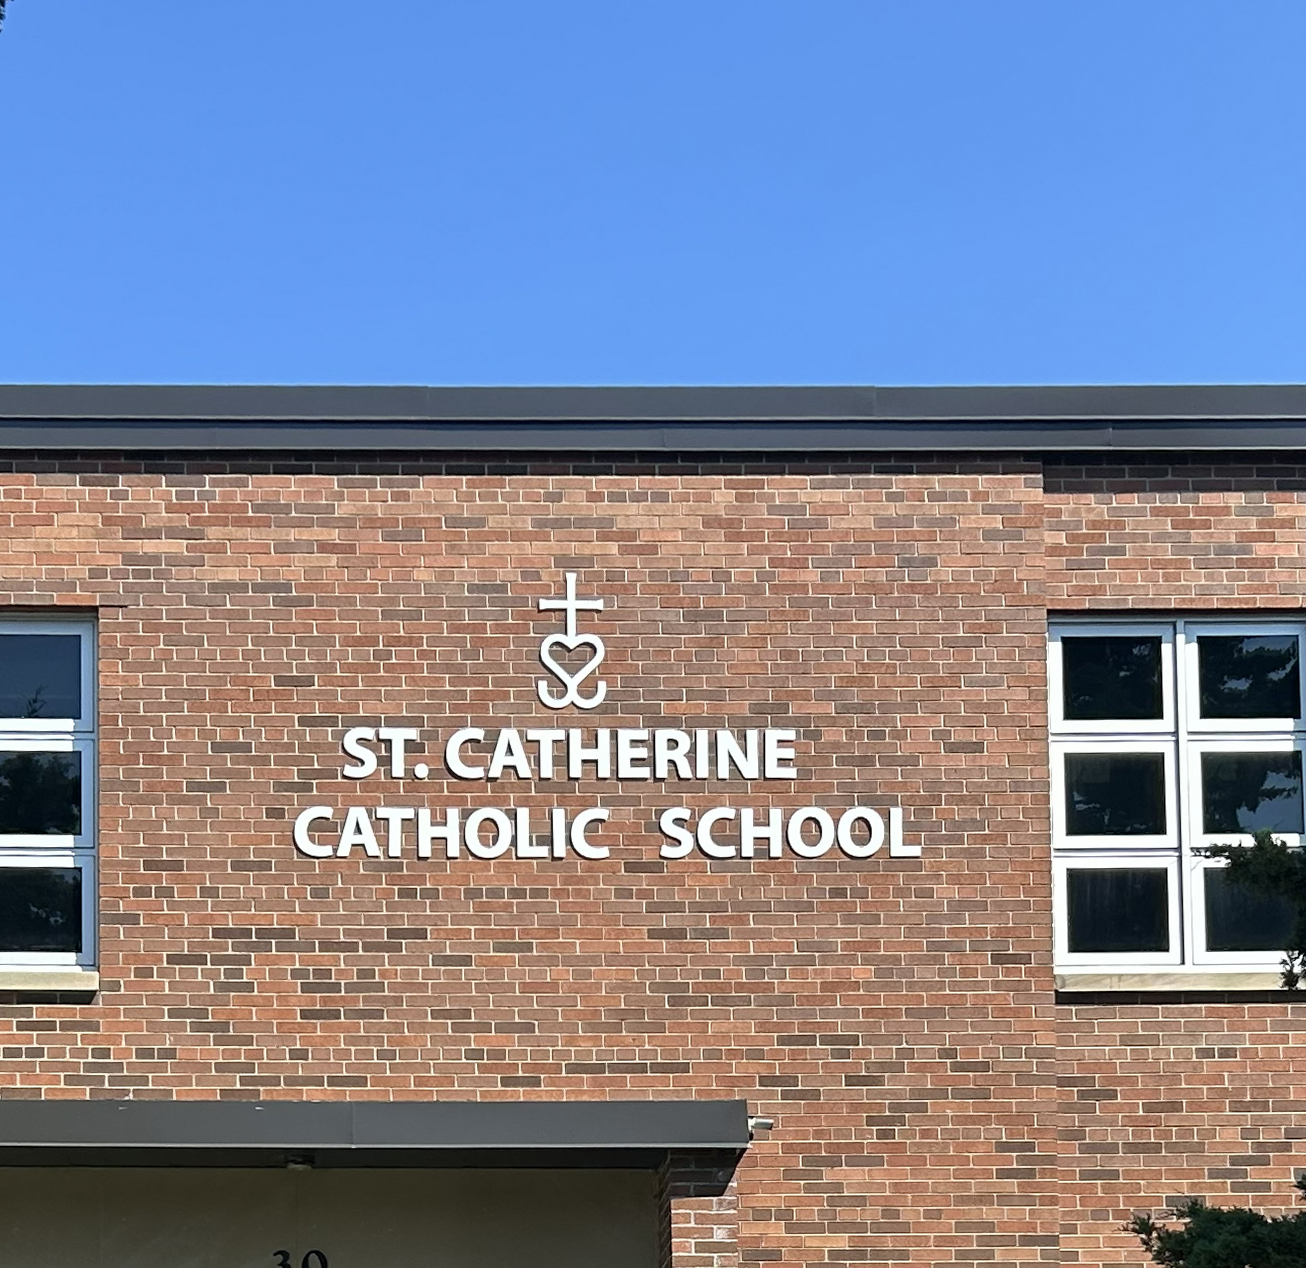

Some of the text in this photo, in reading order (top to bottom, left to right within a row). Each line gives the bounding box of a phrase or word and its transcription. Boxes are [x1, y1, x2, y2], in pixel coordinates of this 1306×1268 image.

[342, 727, 798, 780] ST. CATHERINE
[293, 806, 923, 859] CATHOLIC SCHOOL
